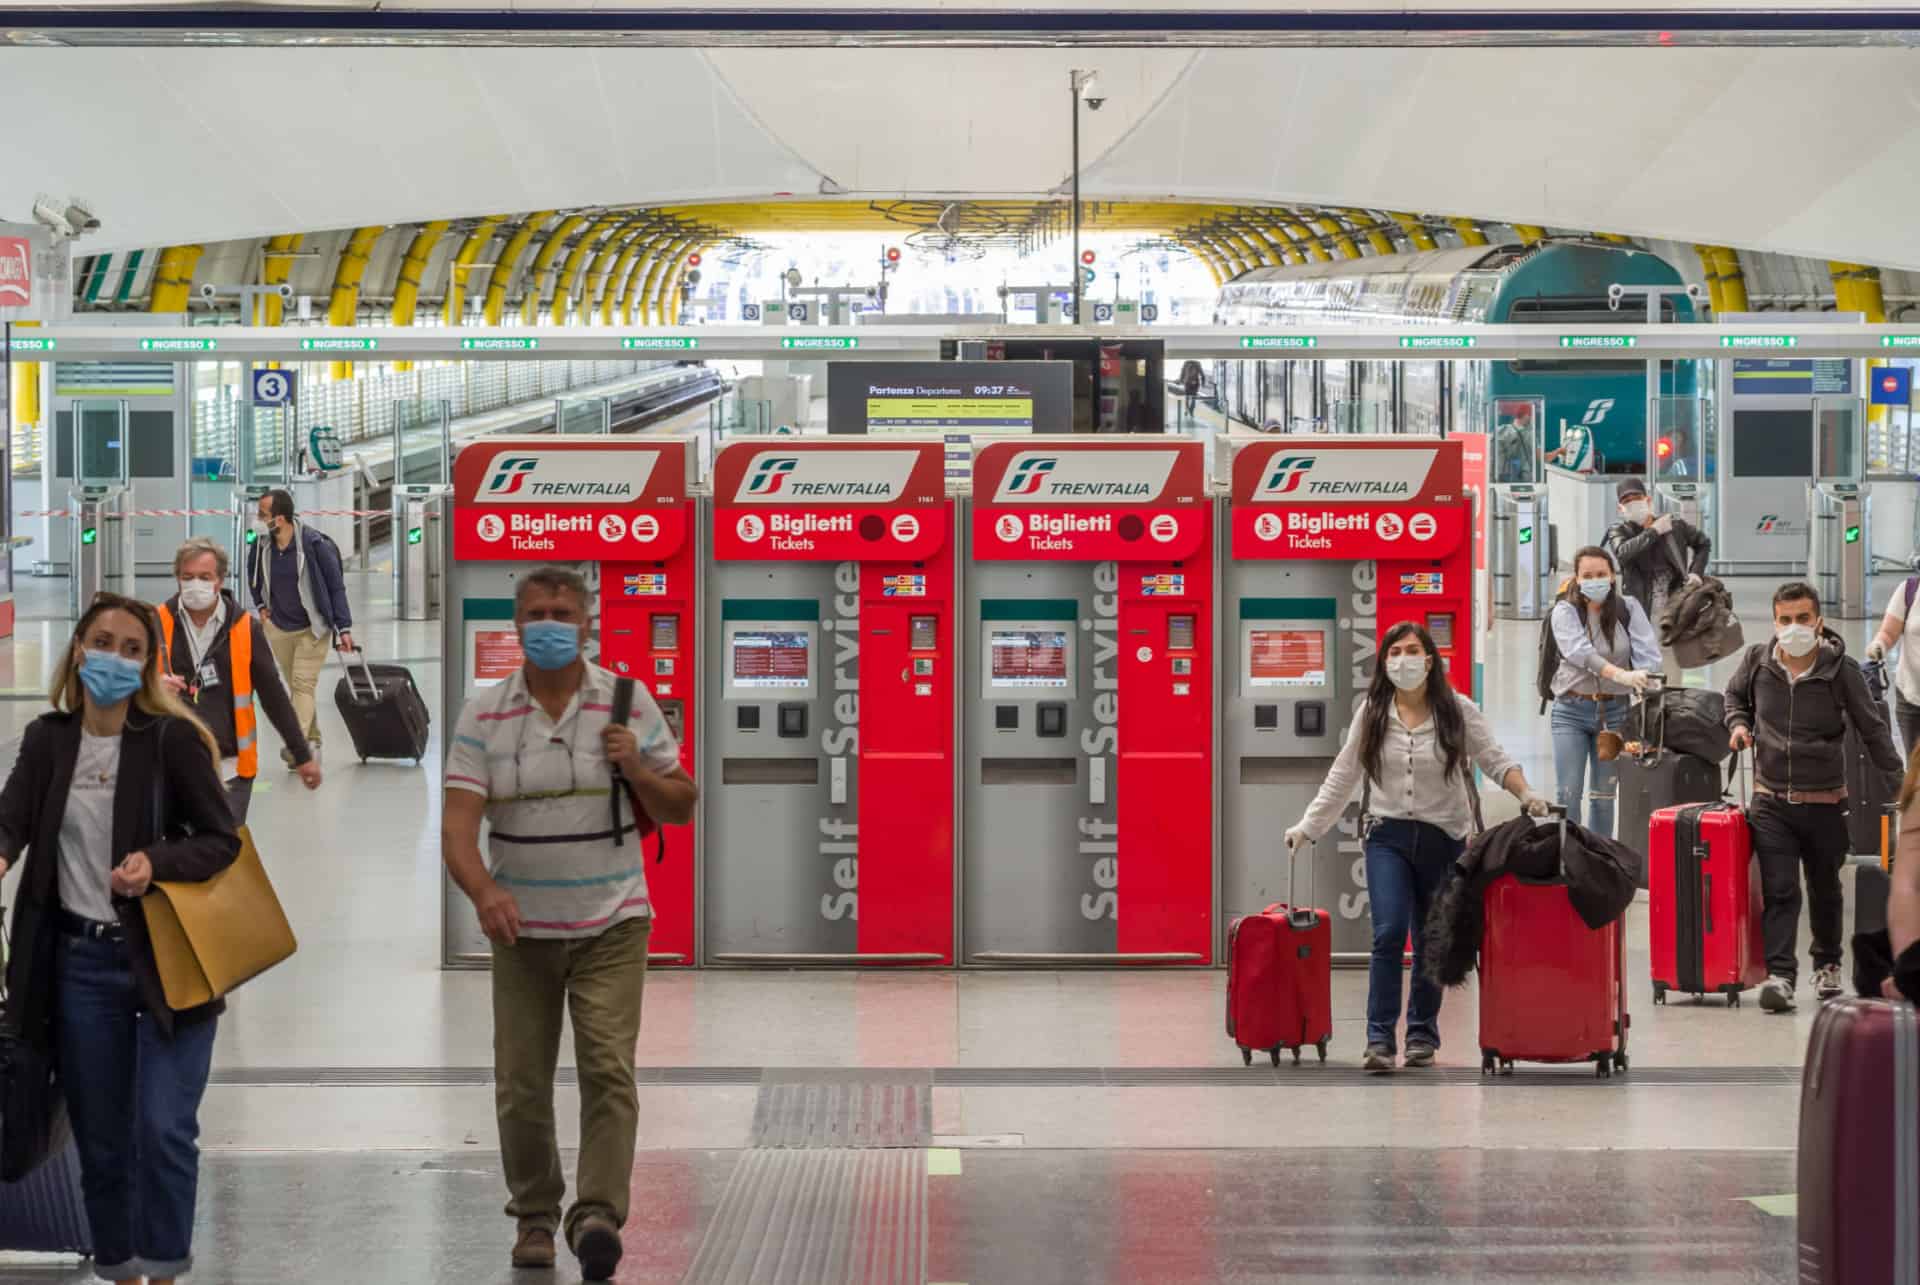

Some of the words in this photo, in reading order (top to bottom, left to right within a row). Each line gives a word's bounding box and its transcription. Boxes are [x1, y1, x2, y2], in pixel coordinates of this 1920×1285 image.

[10, 340, 42, 349] RESSO
[152, 339, 203, 349] INGRESSO
[314, 339, 364, 349] INGRESSO
[475, 339, 525, 348] INGRESSO
[635, 338, 685, 348] INGRESSO
[794, 338, 844, 348] INGRESSO
[1253, 337, 1303, 347] INGRESSO
[1413, 337, 1463, 347] INGRESSO
[1573, 337, 1623, 347] INGRESSO
[1733, 337, 1783, 347] INGRESSO
[265, 377, 280, 397] 3
[974, 385, 1004, 395] 09:37
[531, 482, 630, 495] TRENITALIA
[791, 482, 890, 495] TRENITALIA
[1050, 482, 1149, 495] TRENITALIA
[1309, 481, 1408, 494] TRENITALIA
[511, 513, 592, 535] Biglietti
[770, 513, 852, 535] Biglietti
[1029, 513, 1111, 535] Biglietti
[1288, 512, 1369, 534] Biglietti
[511, 536, 554, 550] Tickets
[770, 536, 814, 550] Tickets
[1029, 536, 1073, 550] Tickets
[1288, 534, 1331, 549] Tickets
